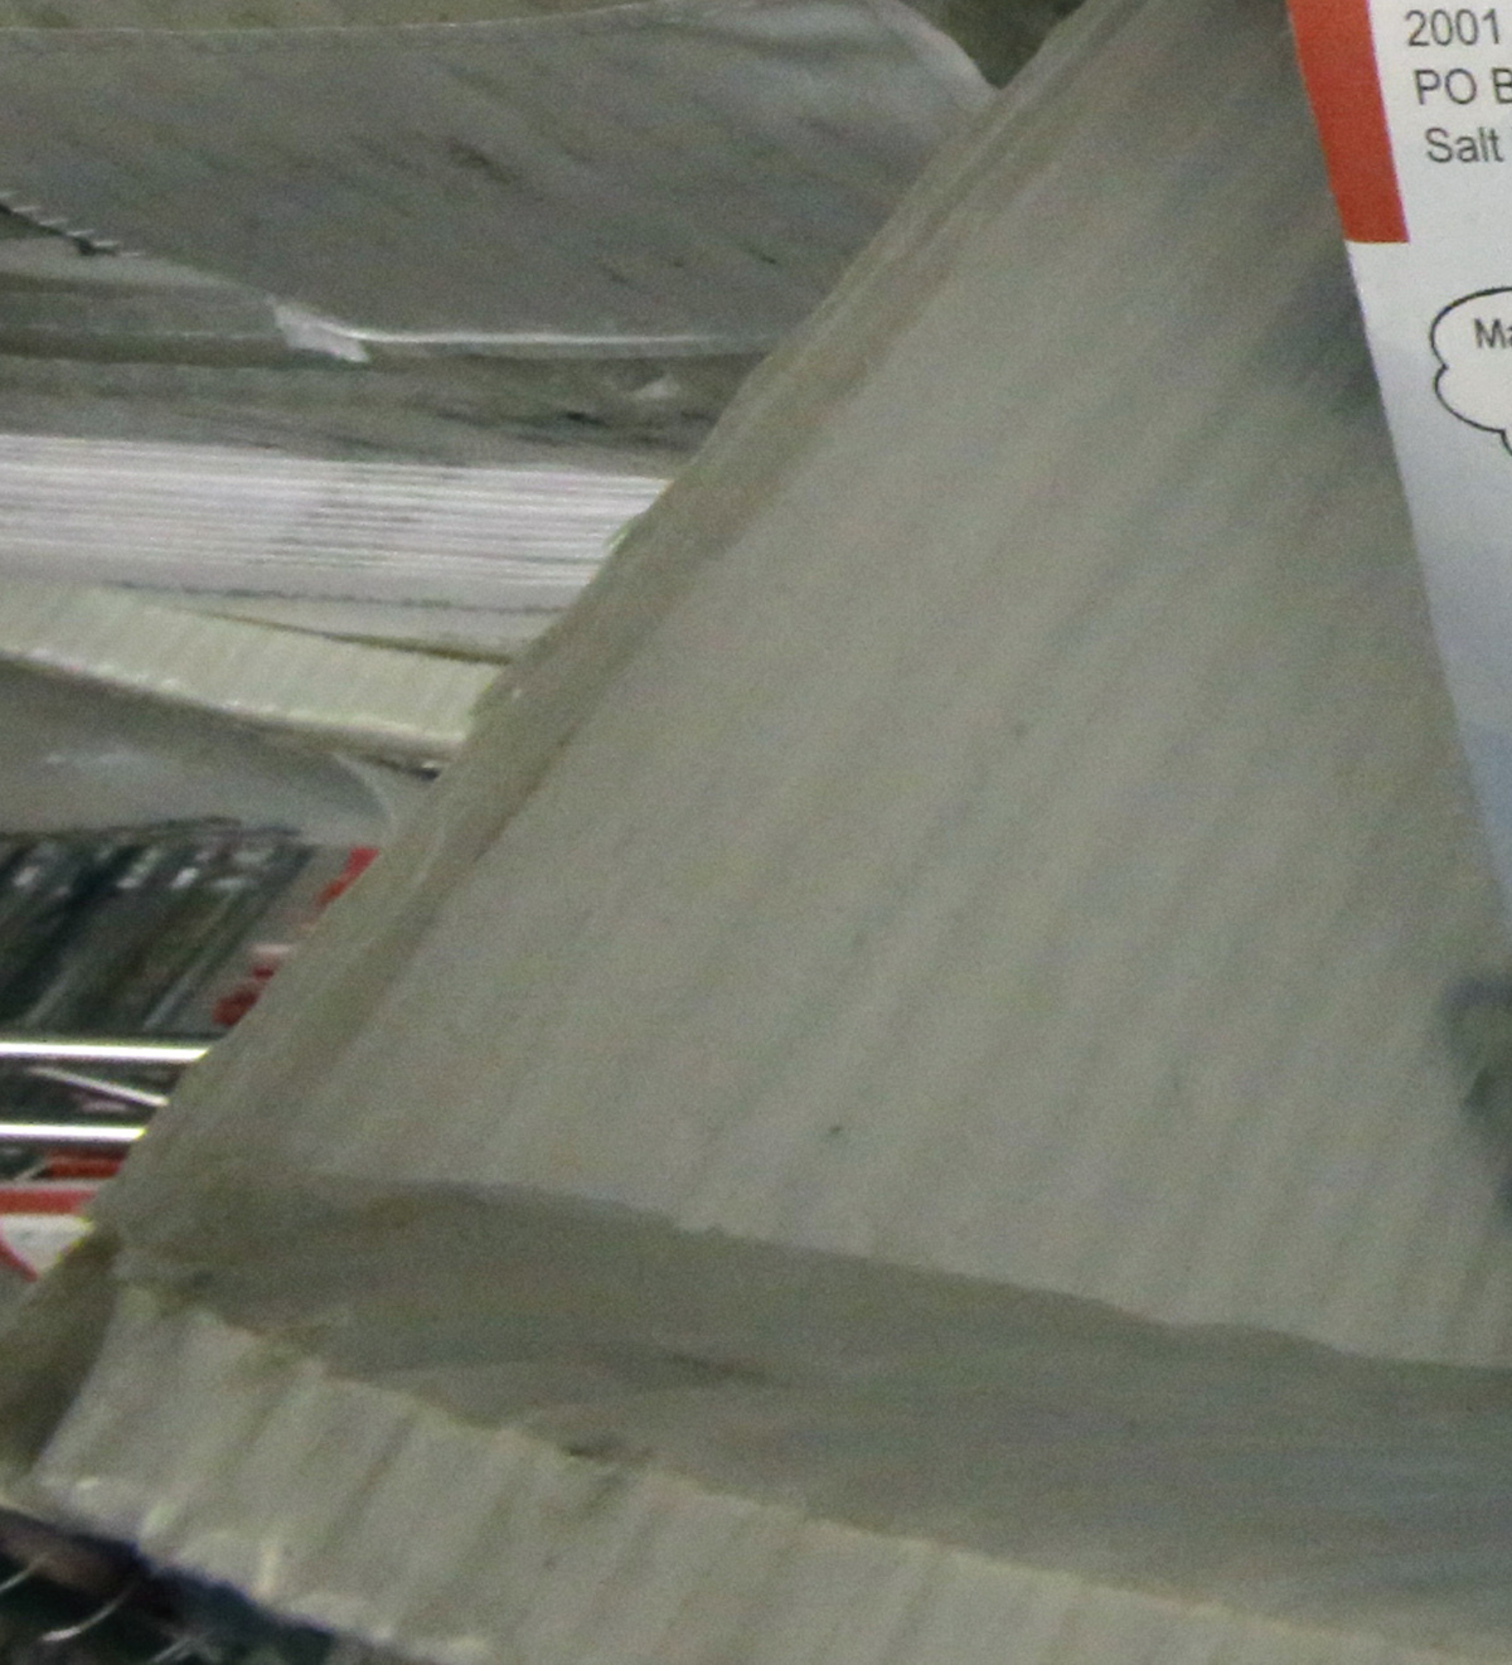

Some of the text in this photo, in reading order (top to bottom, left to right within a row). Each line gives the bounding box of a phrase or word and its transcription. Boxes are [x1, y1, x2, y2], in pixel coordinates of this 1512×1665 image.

[1404, 8, 1500, 48] 2001
[1413, 67, 1478, 106] PO
[1424, 126, 1505, 164] Salt
